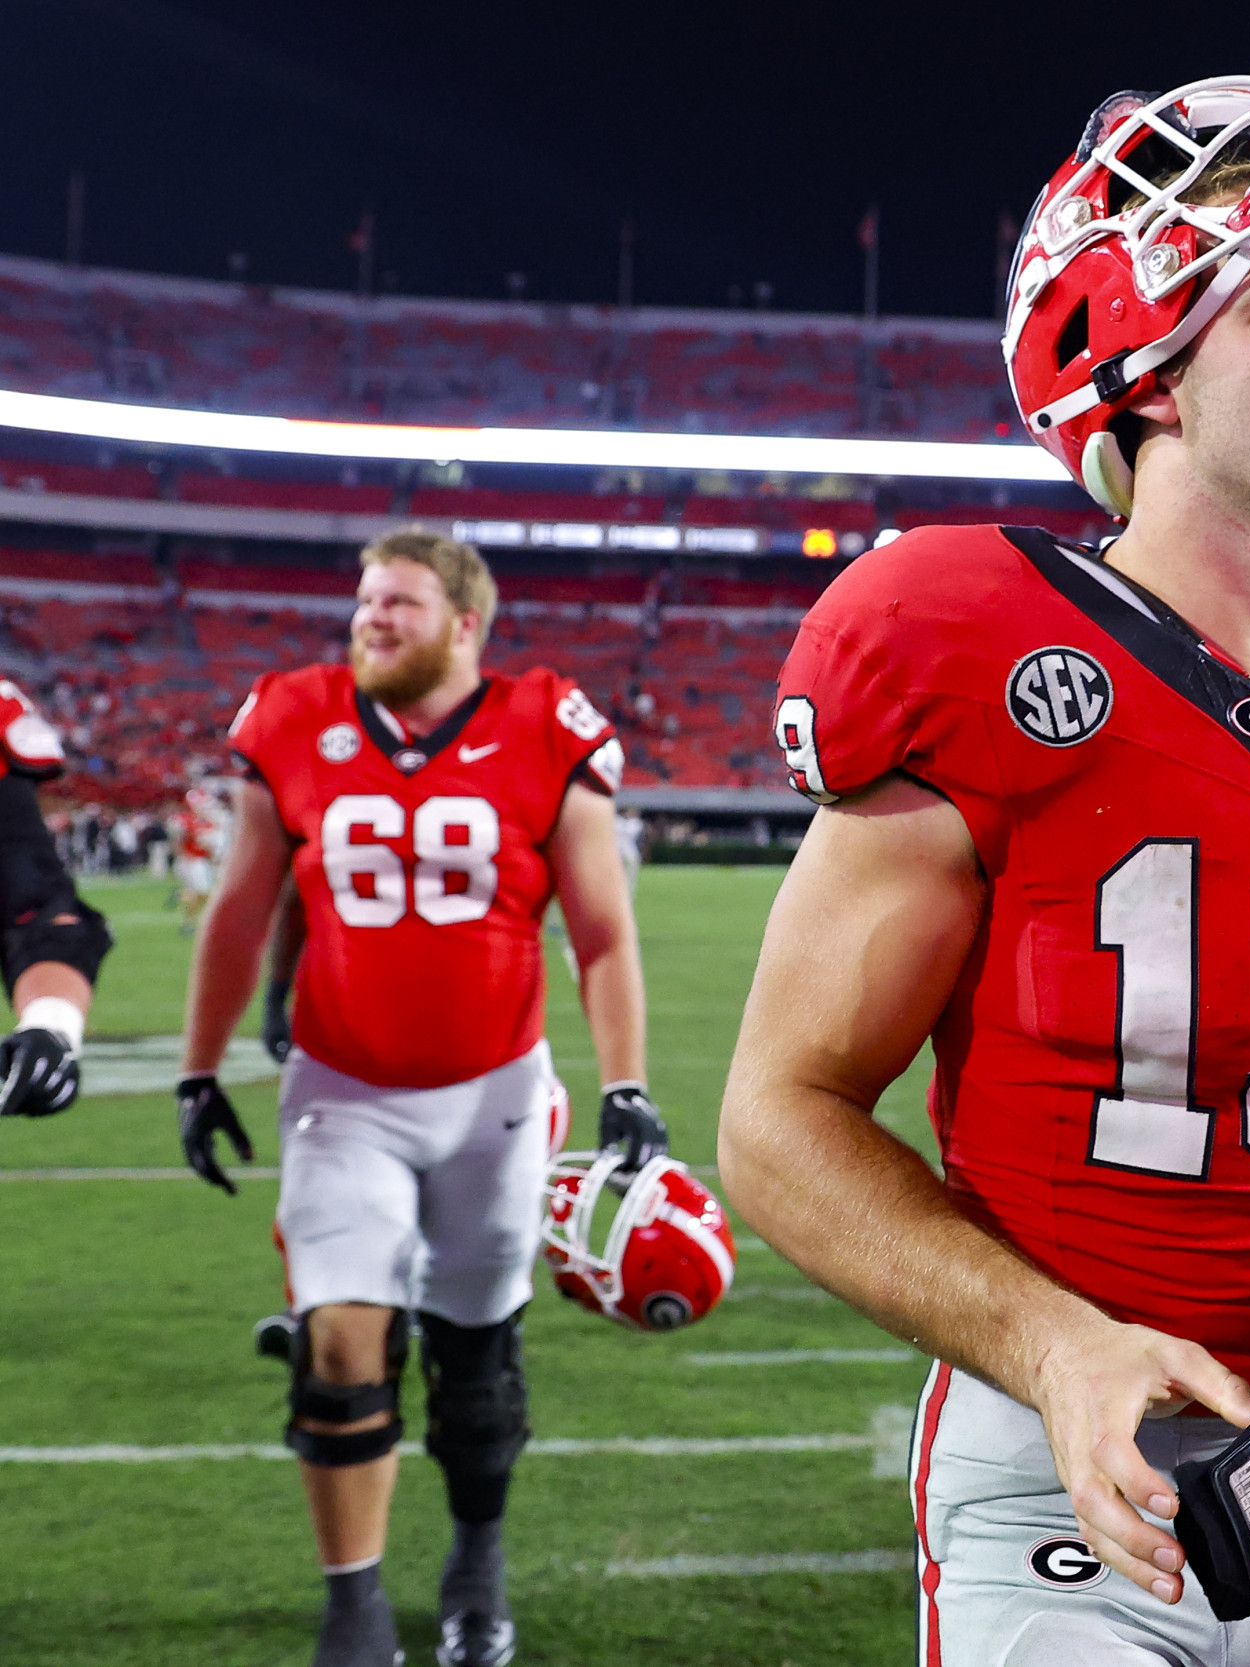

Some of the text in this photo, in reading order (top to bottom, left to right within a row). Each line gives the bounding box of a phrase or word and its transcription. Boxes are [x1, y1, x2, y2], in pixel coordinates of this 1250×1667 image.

[1015, 653, 1104, 738] SEC
[321, 794, 500, 928] 68
[1030, 1539, 1102, 1584] G
